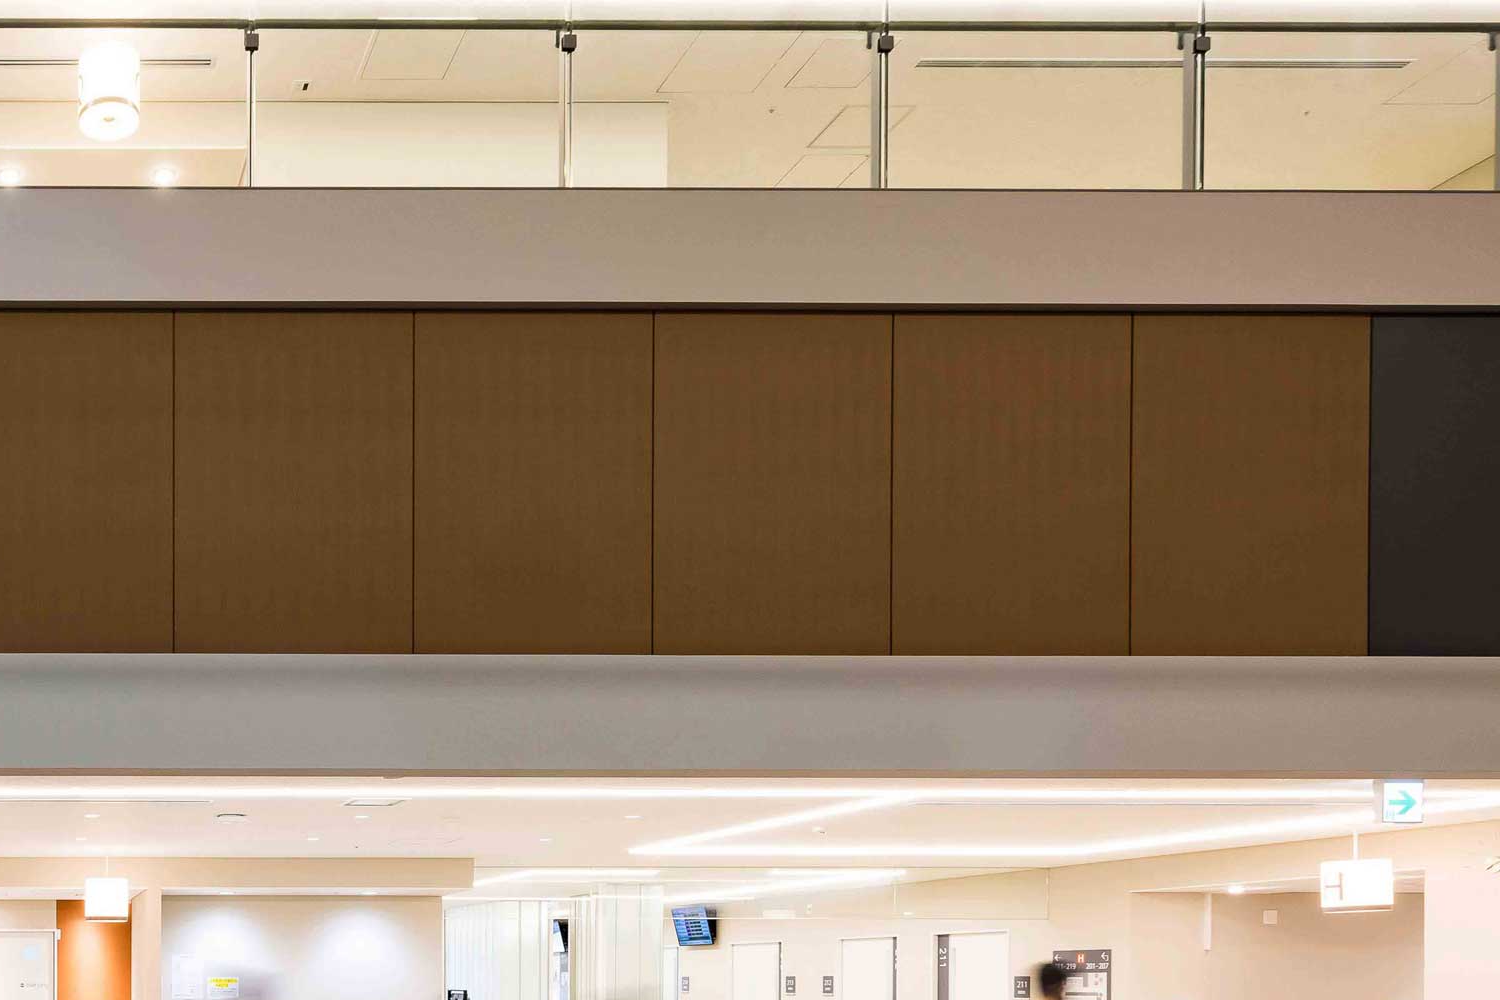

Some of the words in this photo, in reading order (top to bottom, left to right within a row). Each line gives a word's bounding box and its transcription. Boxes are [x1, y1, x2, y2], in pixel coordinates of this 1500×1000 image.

[939, 948, 947, 967] 211
[1077, 954, 1085, 963] H
[1016, 980, 1028, 989] 211
